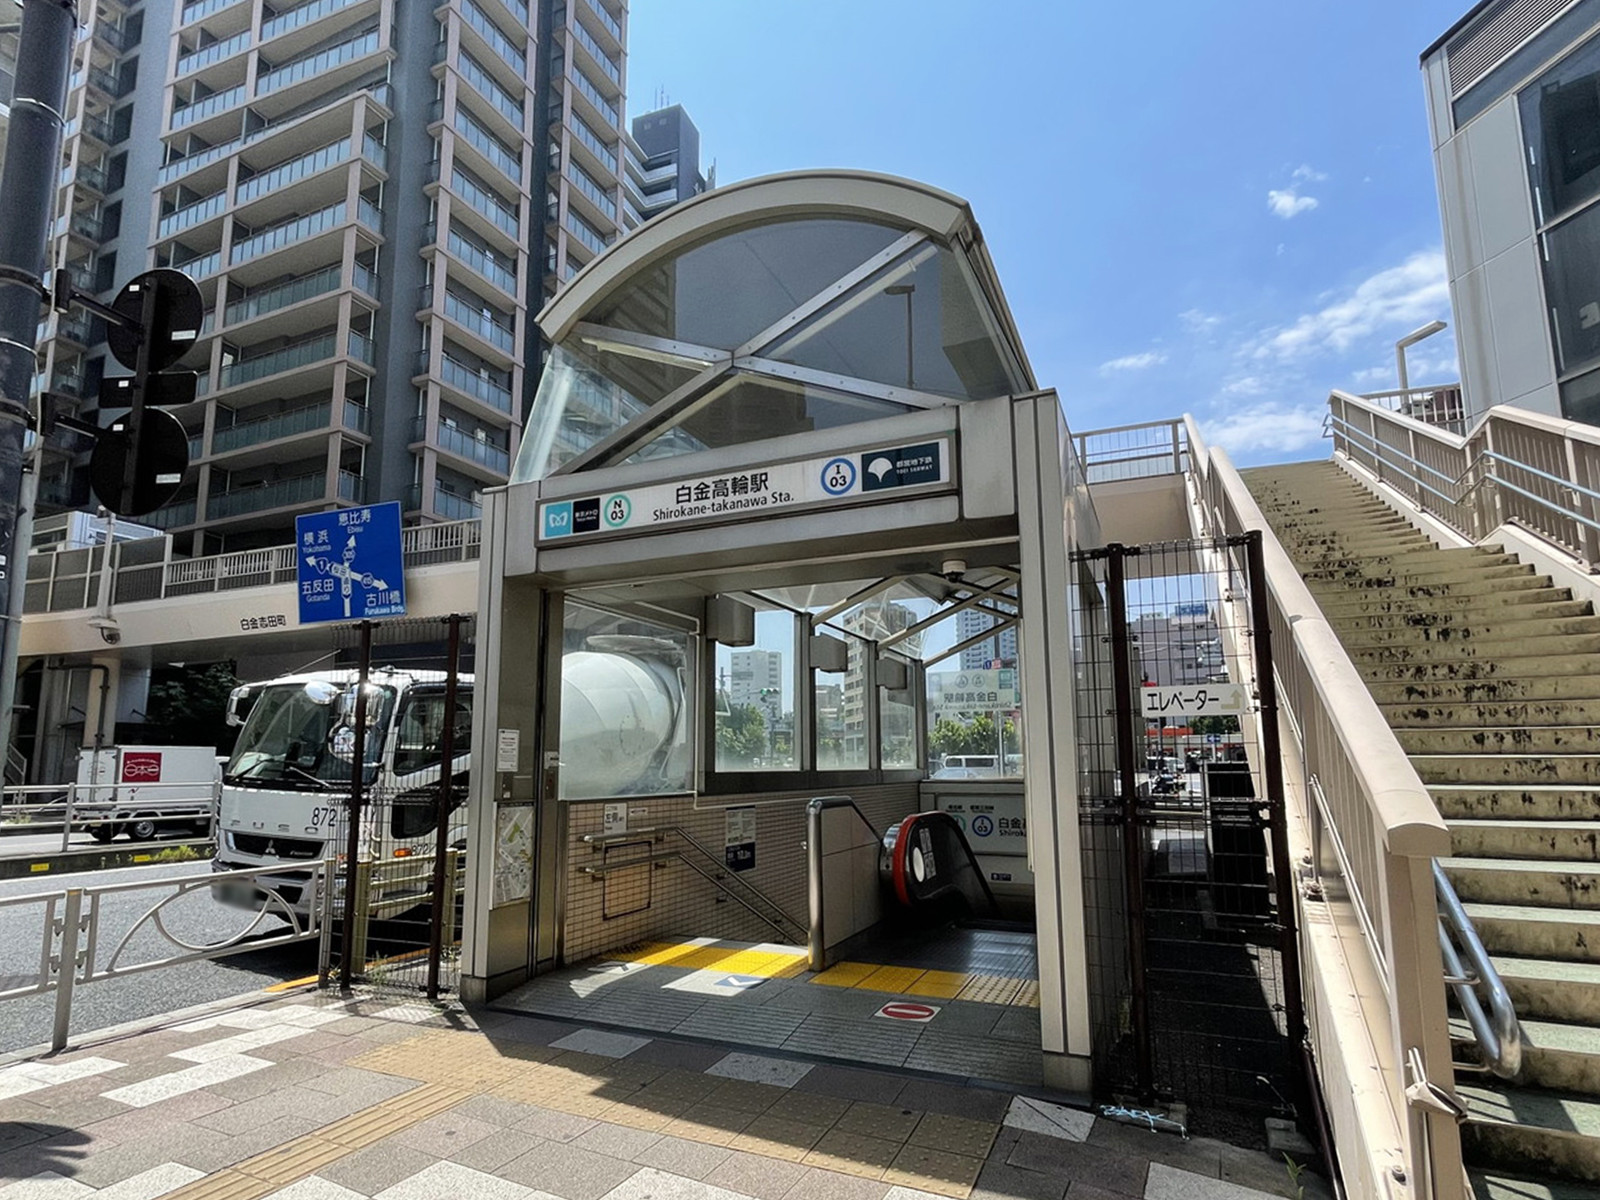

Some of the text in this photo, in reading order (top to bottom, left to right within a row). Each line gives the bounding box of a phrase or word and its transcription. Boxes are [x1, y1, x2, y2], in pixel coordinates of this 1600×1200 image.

[835, 464, 841, 475] I
[675, 472, 769, 504] 白金高輪駅
[829, 475, 847, 488] 03
[613, 500, 622, 509] N
[652, 491, 795, 521] Shirokane-takanawa Sta.
[338, 509, 371, 526] 恵比寿
[610, 510, 625, 521] 03
[303, 529, 329, 545] 横浜
[319, 561, 324, 570] 1
[302, 578, 334, 595] 五反田
[365, 589, 400, 607] 古川橋
[1146, 690, 1219, 711] エレベーター
[311, 807, 337, 827] 872
